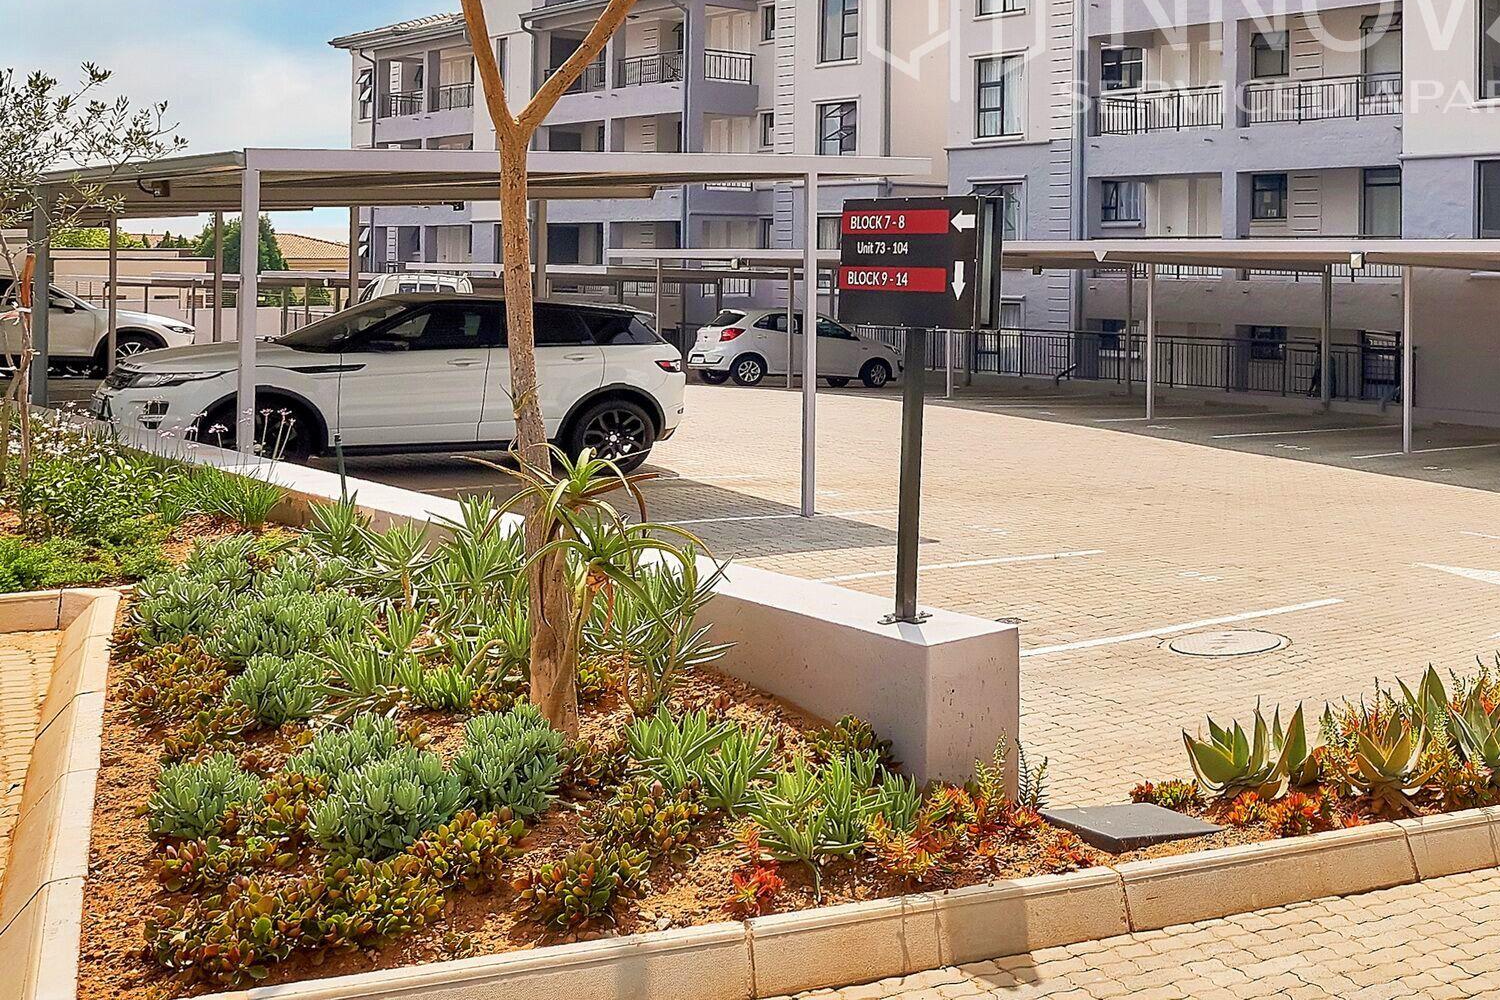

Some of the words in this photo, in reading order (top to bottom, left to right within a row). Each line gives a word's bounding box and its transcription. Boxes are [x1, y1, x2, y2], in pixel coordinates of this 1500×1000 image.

[850, 215, 882, 230] BLOCK
[884, 215, 891, 229] 7
[898, 215, 906, 229] 8
[857, 242, 874, 254] Unit
[875, 242, 886, 254] 73
[892, 242, 909, 254] 104
[848, 271, 880, 285] BLOCK
[881, 272, 888, 285] 9
[896, 272, 908, 286] 14
